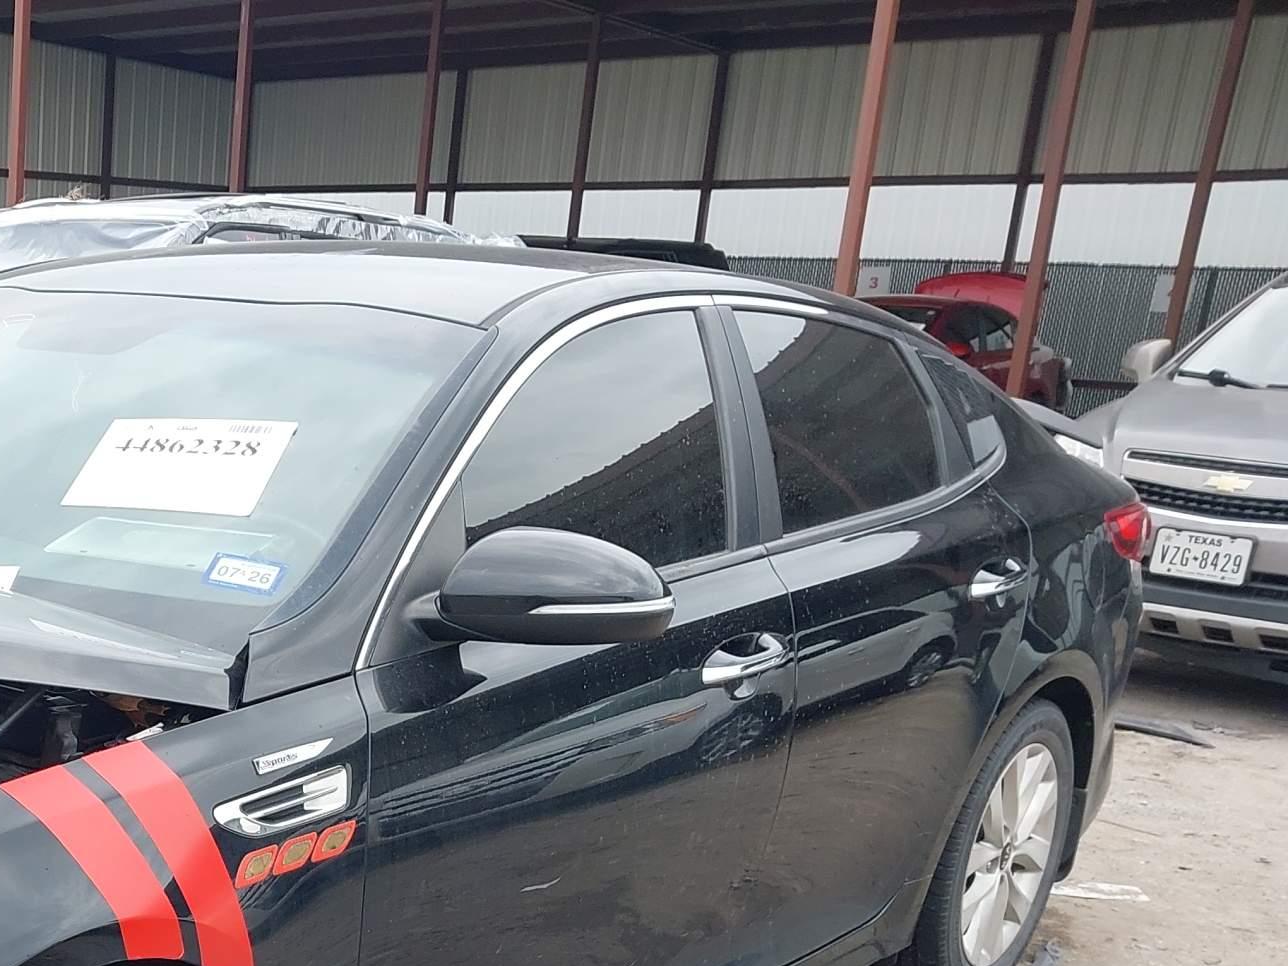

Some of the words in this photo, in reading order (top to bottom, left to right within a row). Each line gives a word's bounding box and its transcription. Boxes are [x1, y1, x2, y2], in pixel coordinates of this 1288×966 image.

[868, 276, 879, 289] 3
[115, 437, 262, 457] 44862328
[1187, 534, 1224, 547] TEXAS
